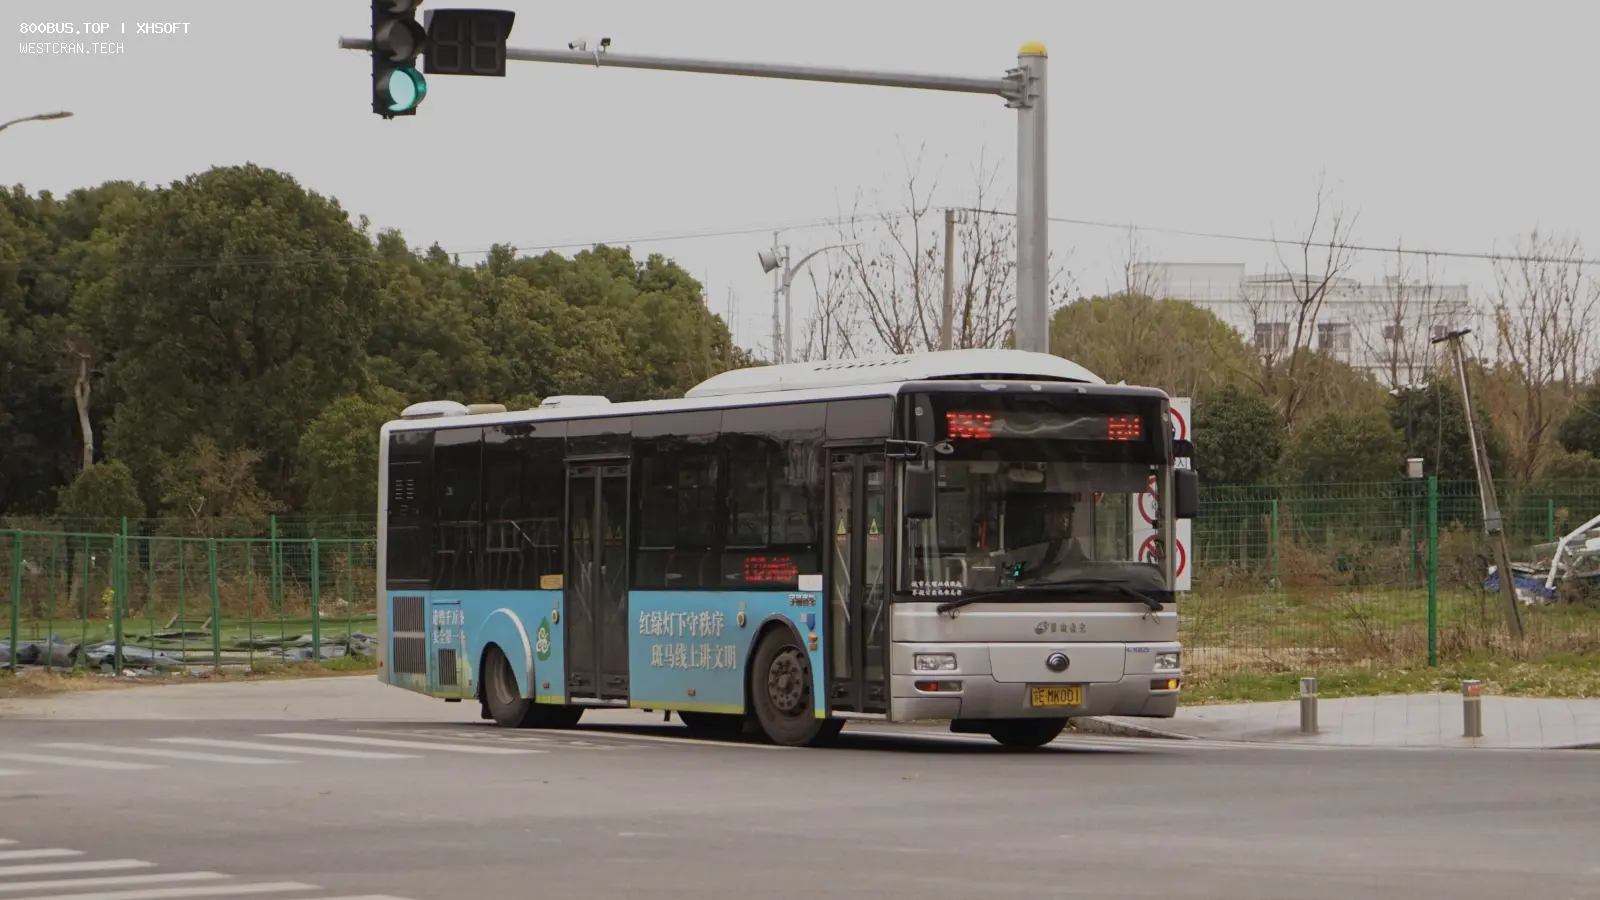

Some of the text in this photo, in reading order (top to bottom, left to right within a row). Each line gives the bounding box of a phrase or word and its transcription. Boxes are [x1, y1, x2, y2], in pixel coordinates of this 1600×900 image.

[639, 610, 724, 637] 红绿灯下守秩序
[651, 642, 738, 670] 斑马线上讲文明
